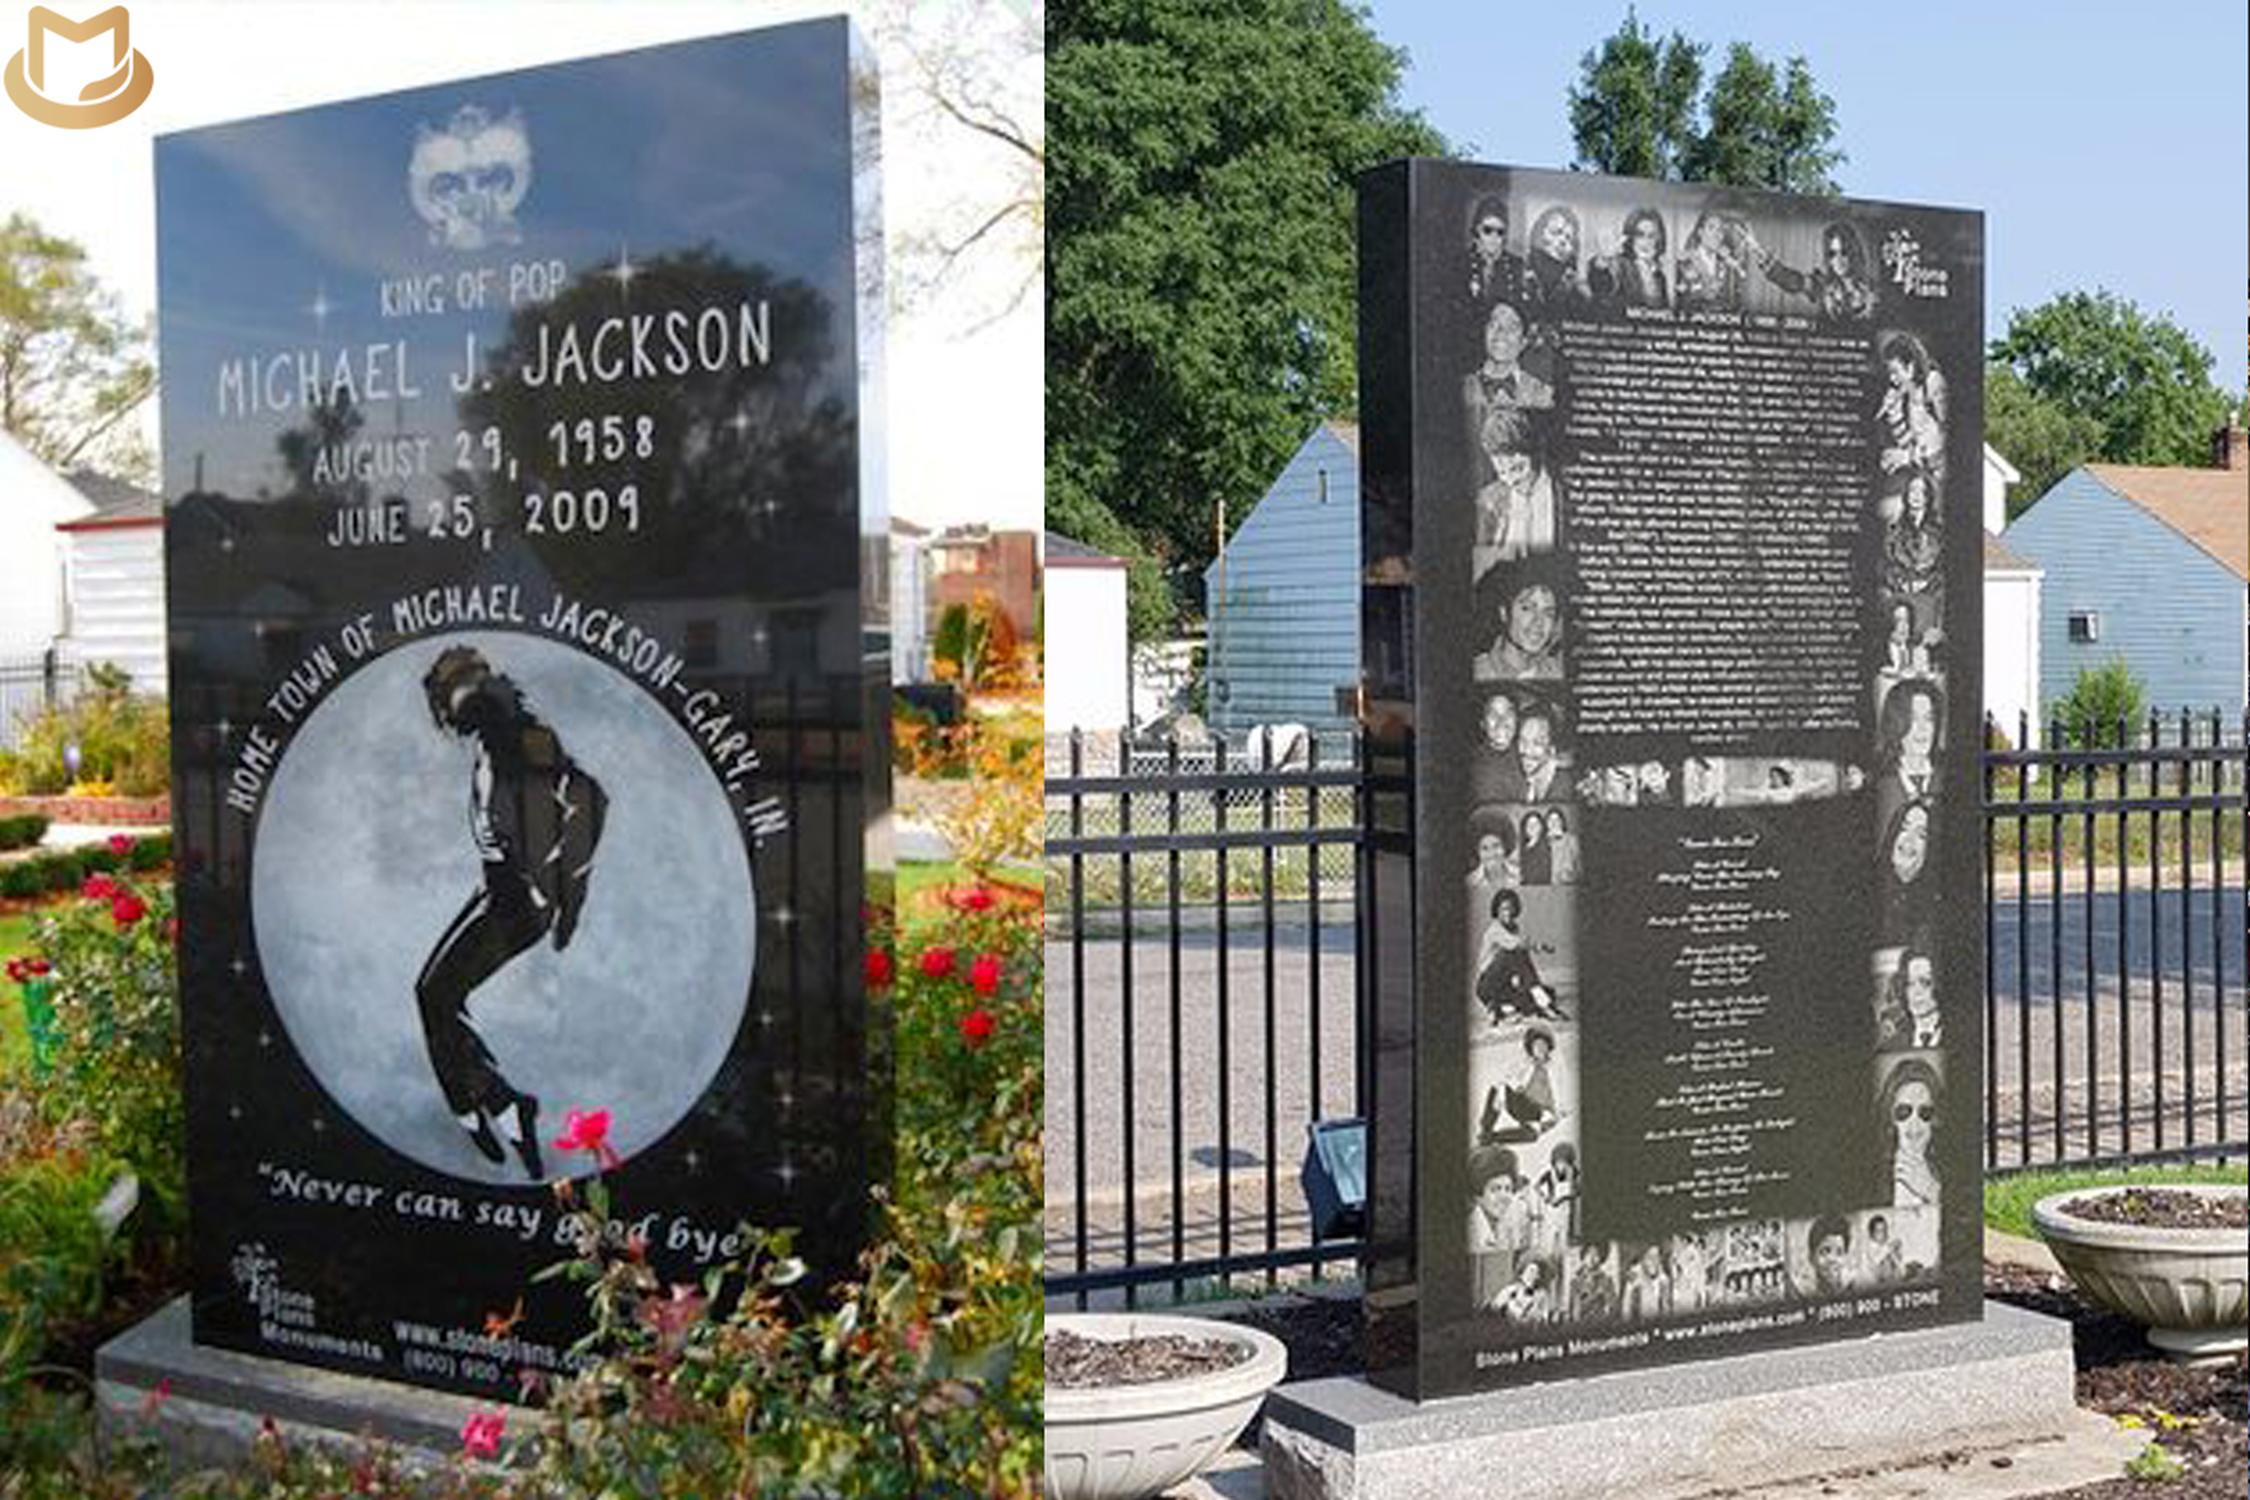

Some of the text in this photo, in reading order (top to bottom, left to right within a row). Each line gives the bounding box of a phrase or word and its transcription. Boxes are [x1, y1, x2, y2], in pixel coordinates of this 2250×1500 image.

[380, 259, 567, 318] KING OF POP
[219, 301, 769, 418] MICHAEL J. JACKSON
[313, 415, 654, 484] AUGUST 29, 1958
[327, 485, 639, 550] JUNE 25, 2009
[227, 725, 279, 812] HOME
[267, 644, 339, 723] TOWN
[341, 613, 375, 659] OF
[392, 583, 525, 634] MICHAEL
[744, 797, 789, 848] IN.
[395, 1190, 462, 1221] can
[475, 1201, 541, 1240] say
[553, 1213, 660, 1247] god
